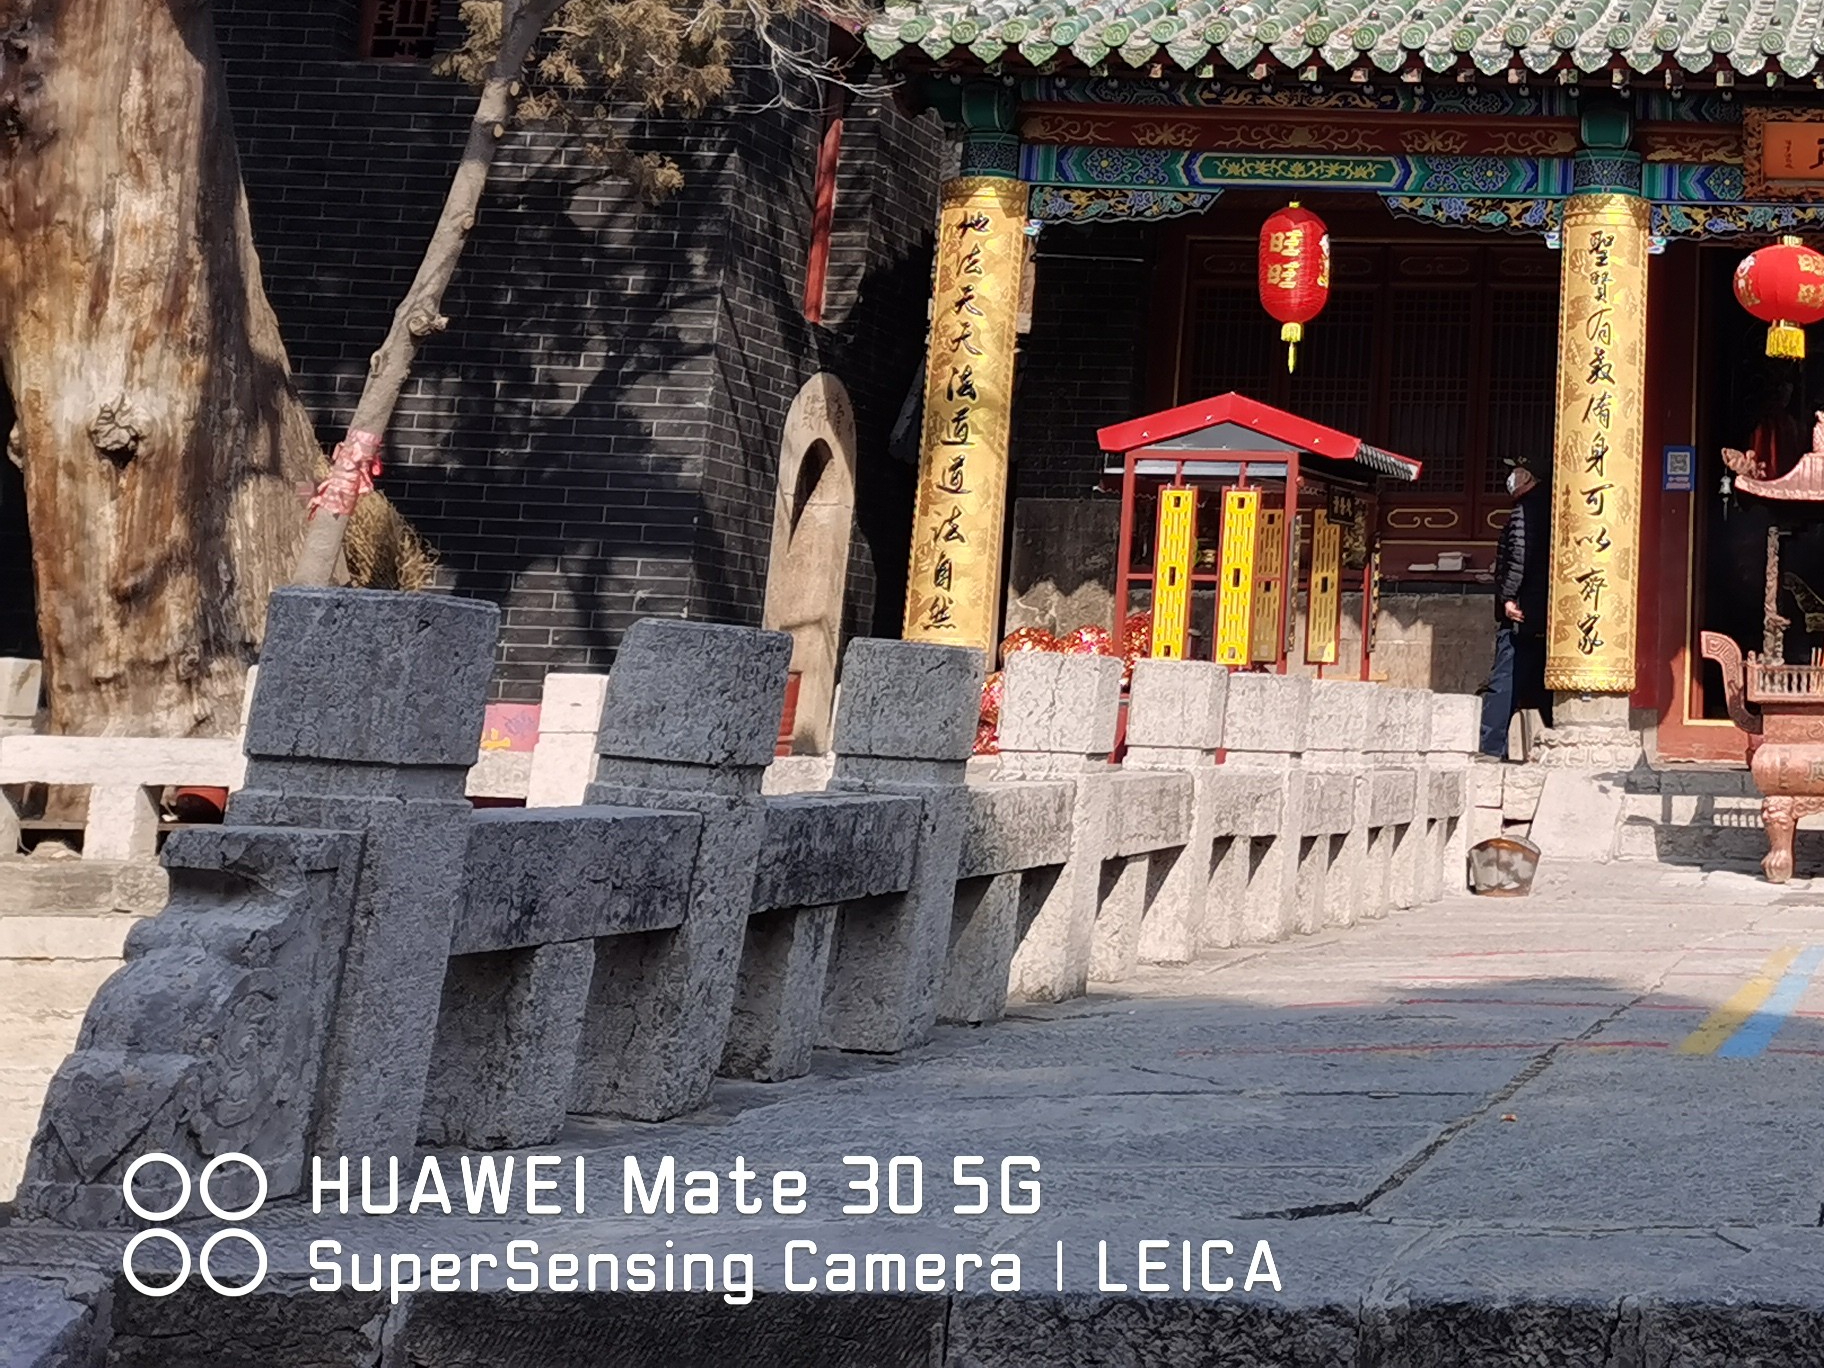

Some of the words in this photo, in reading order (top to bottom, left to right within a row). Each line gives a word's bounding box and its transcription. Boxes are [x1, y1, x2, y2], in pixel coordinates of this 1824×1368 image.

[1266, 228, 1304, 289] 旺旺
[921, 209, 990, 631] 地法天天法道道法自然
